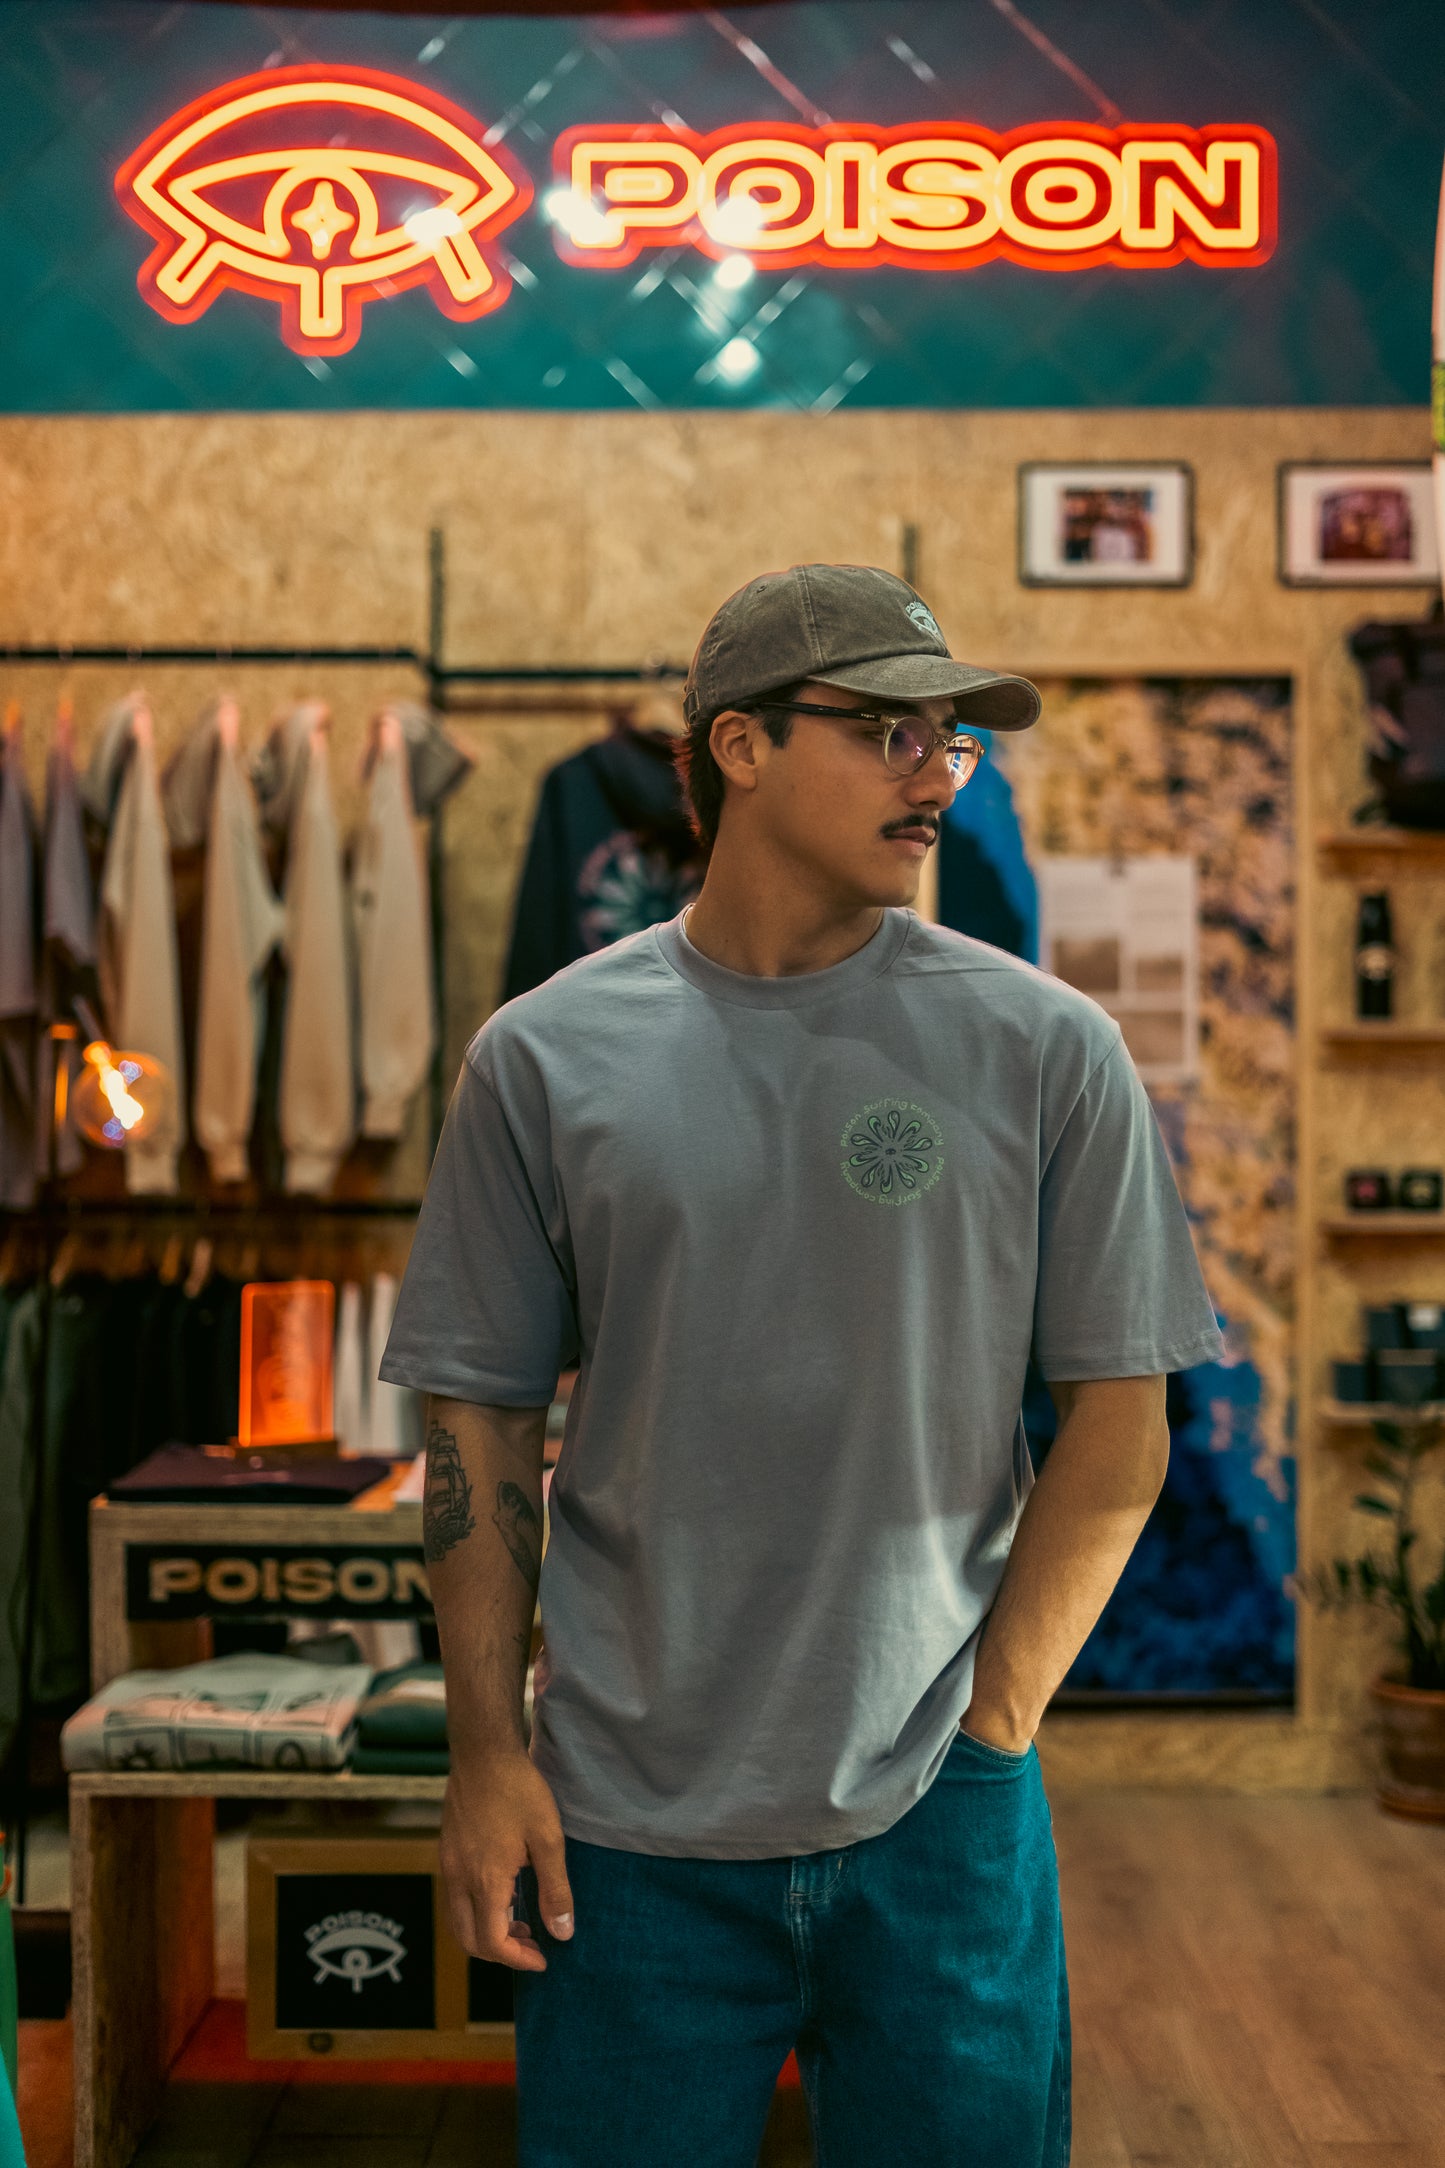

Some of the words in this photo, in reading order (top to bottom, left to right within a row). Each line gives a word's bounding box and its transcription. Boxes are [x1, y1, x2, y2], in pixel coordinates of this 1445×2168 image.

[570, 139, 1261, 251] POISON
[148, 1557, 432, 1603] POISON
[303, 1910, 404, 1943] POISON
